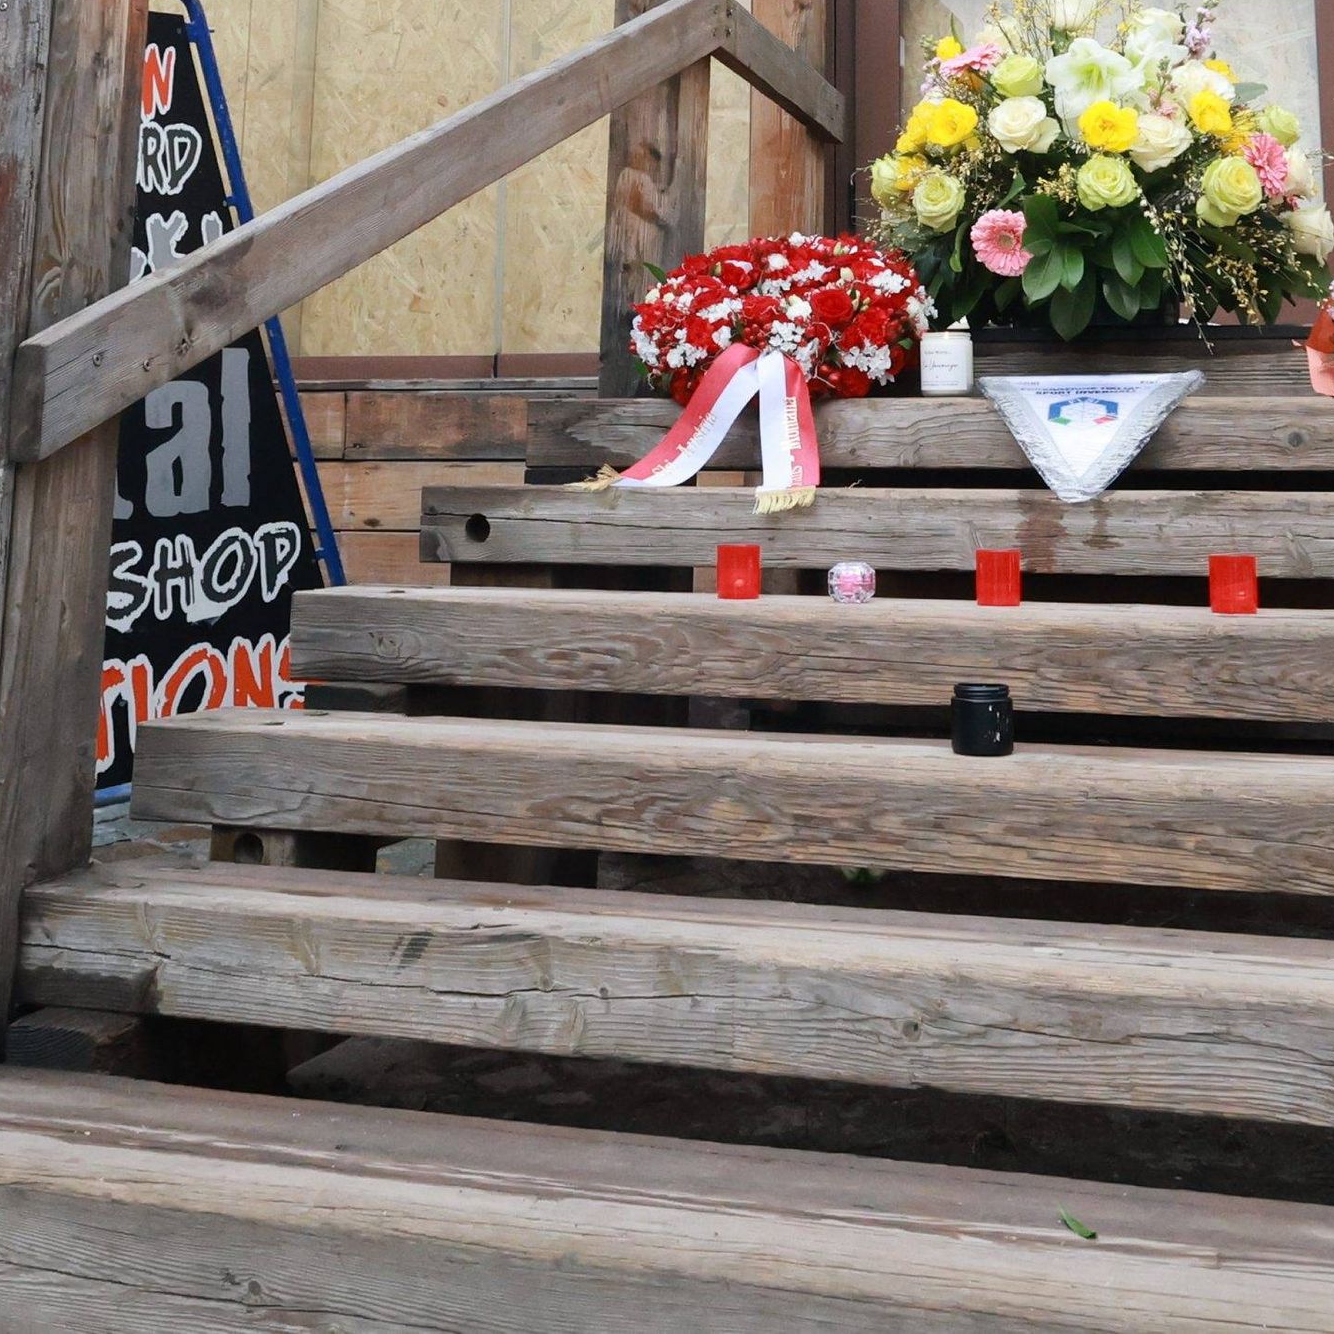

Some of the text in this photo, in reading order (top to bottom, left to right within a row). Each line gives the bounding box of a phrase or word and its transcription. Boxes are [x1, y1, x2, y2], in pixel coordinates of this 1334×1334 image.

[675, 412, 717, 458] Austria
[781, 396, 802, 451] Montana
[106, 521, 301, 633] SHOP
